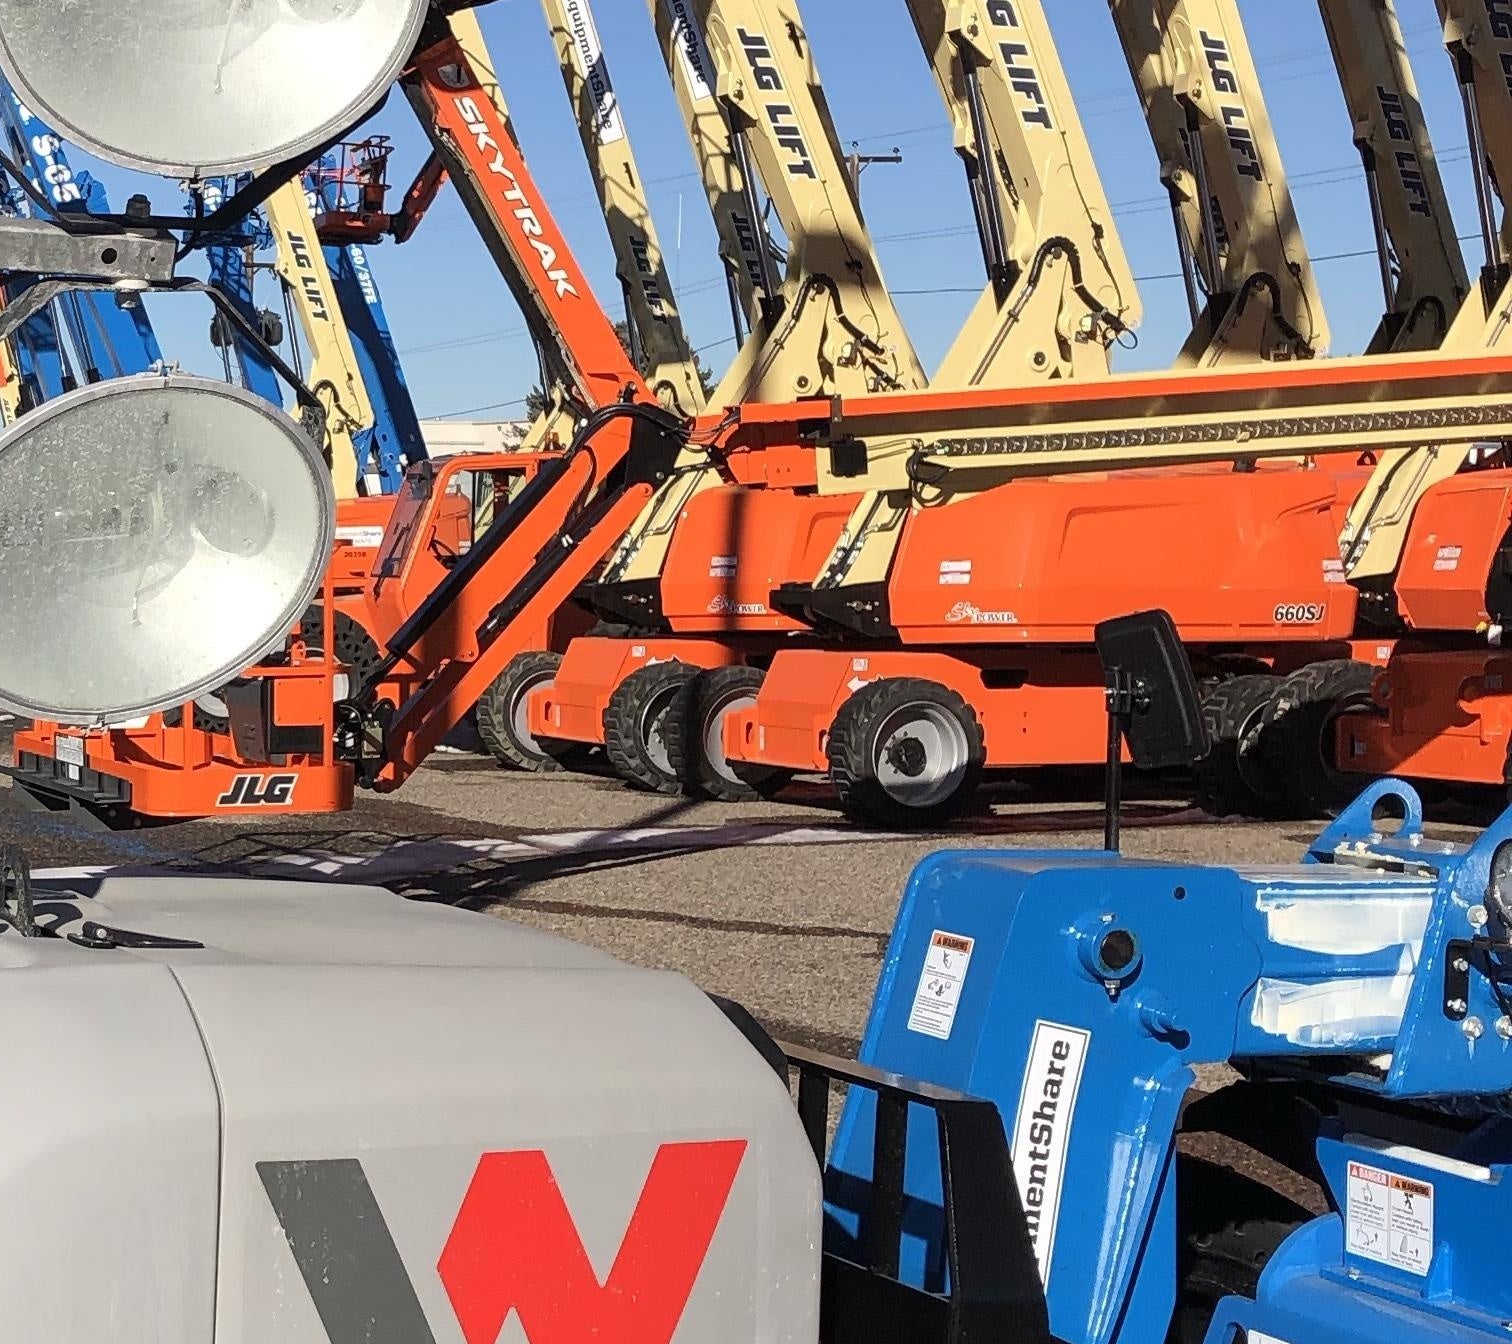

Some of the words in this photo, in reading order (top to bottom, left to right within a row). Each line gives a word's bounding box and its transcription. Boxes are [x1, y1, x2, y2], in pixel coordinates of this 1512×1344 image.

[736, 27, 784, 91] JLG
[765, 104, 817, 180] LIFT
[998, 42, 1054, 130] LIFT
[1199, 30, 1239, 94] JLG
[1221, 106, 1263, 182] LIFT
[1376, 85, 1411, 142] JLG
[1395, 151, 1432, 218] LIFT
[452, 96, 580, 300] SKYTRAK
[287, 230, 312, 269] JLG
[301, 276, 329, 322] LIFT
[629, 235, 654, 273] JLG
[642, 279, 668, 325] LIFT
[1273, 604, 1326, 623] 660SJ
[216, 774, 298, 807] JLG
[1359, 1168, 1387, 1186] DANGER
